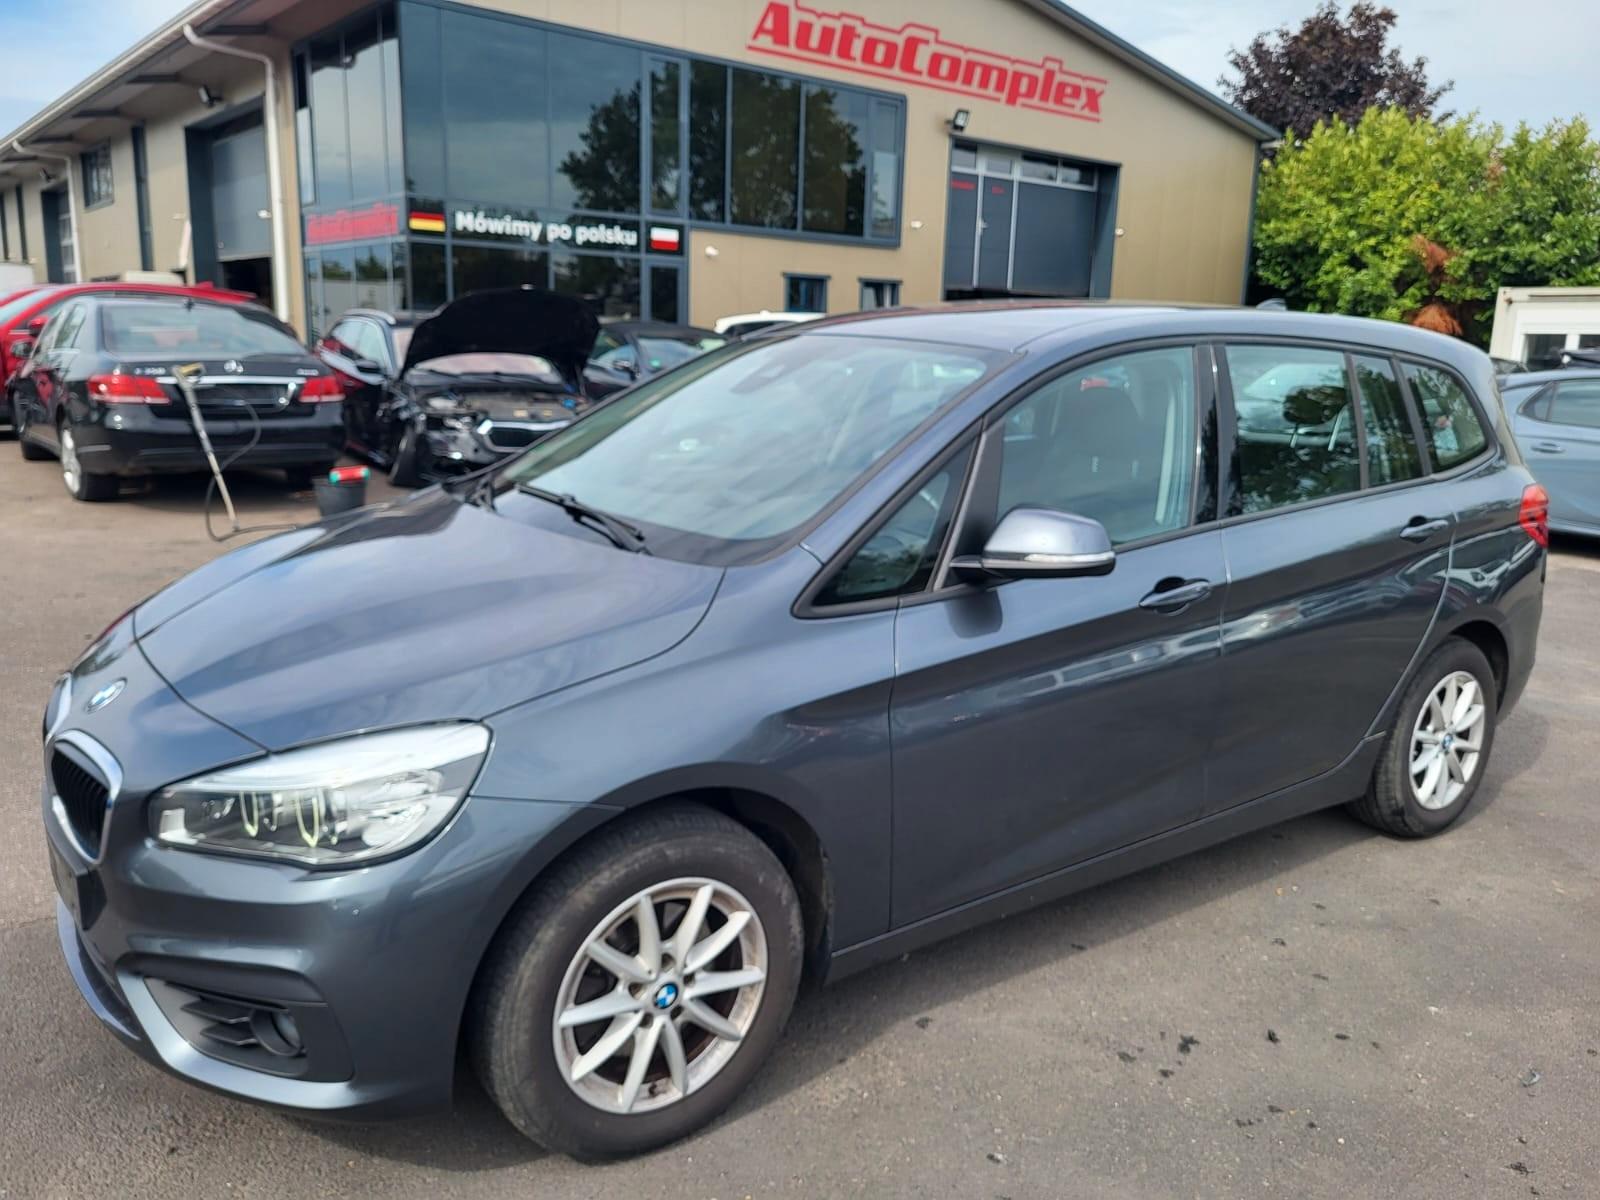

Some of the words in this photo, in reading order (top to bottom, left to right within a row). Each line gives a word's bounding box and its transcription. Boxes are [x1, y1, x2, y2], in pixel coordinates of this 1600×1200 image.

[750, 1, 1105, 116] AutoComplex
[455, 210, 542, 242] Mówimy
[546, 222, 572, 242] po
[575, 224, 638, 246] polsku
